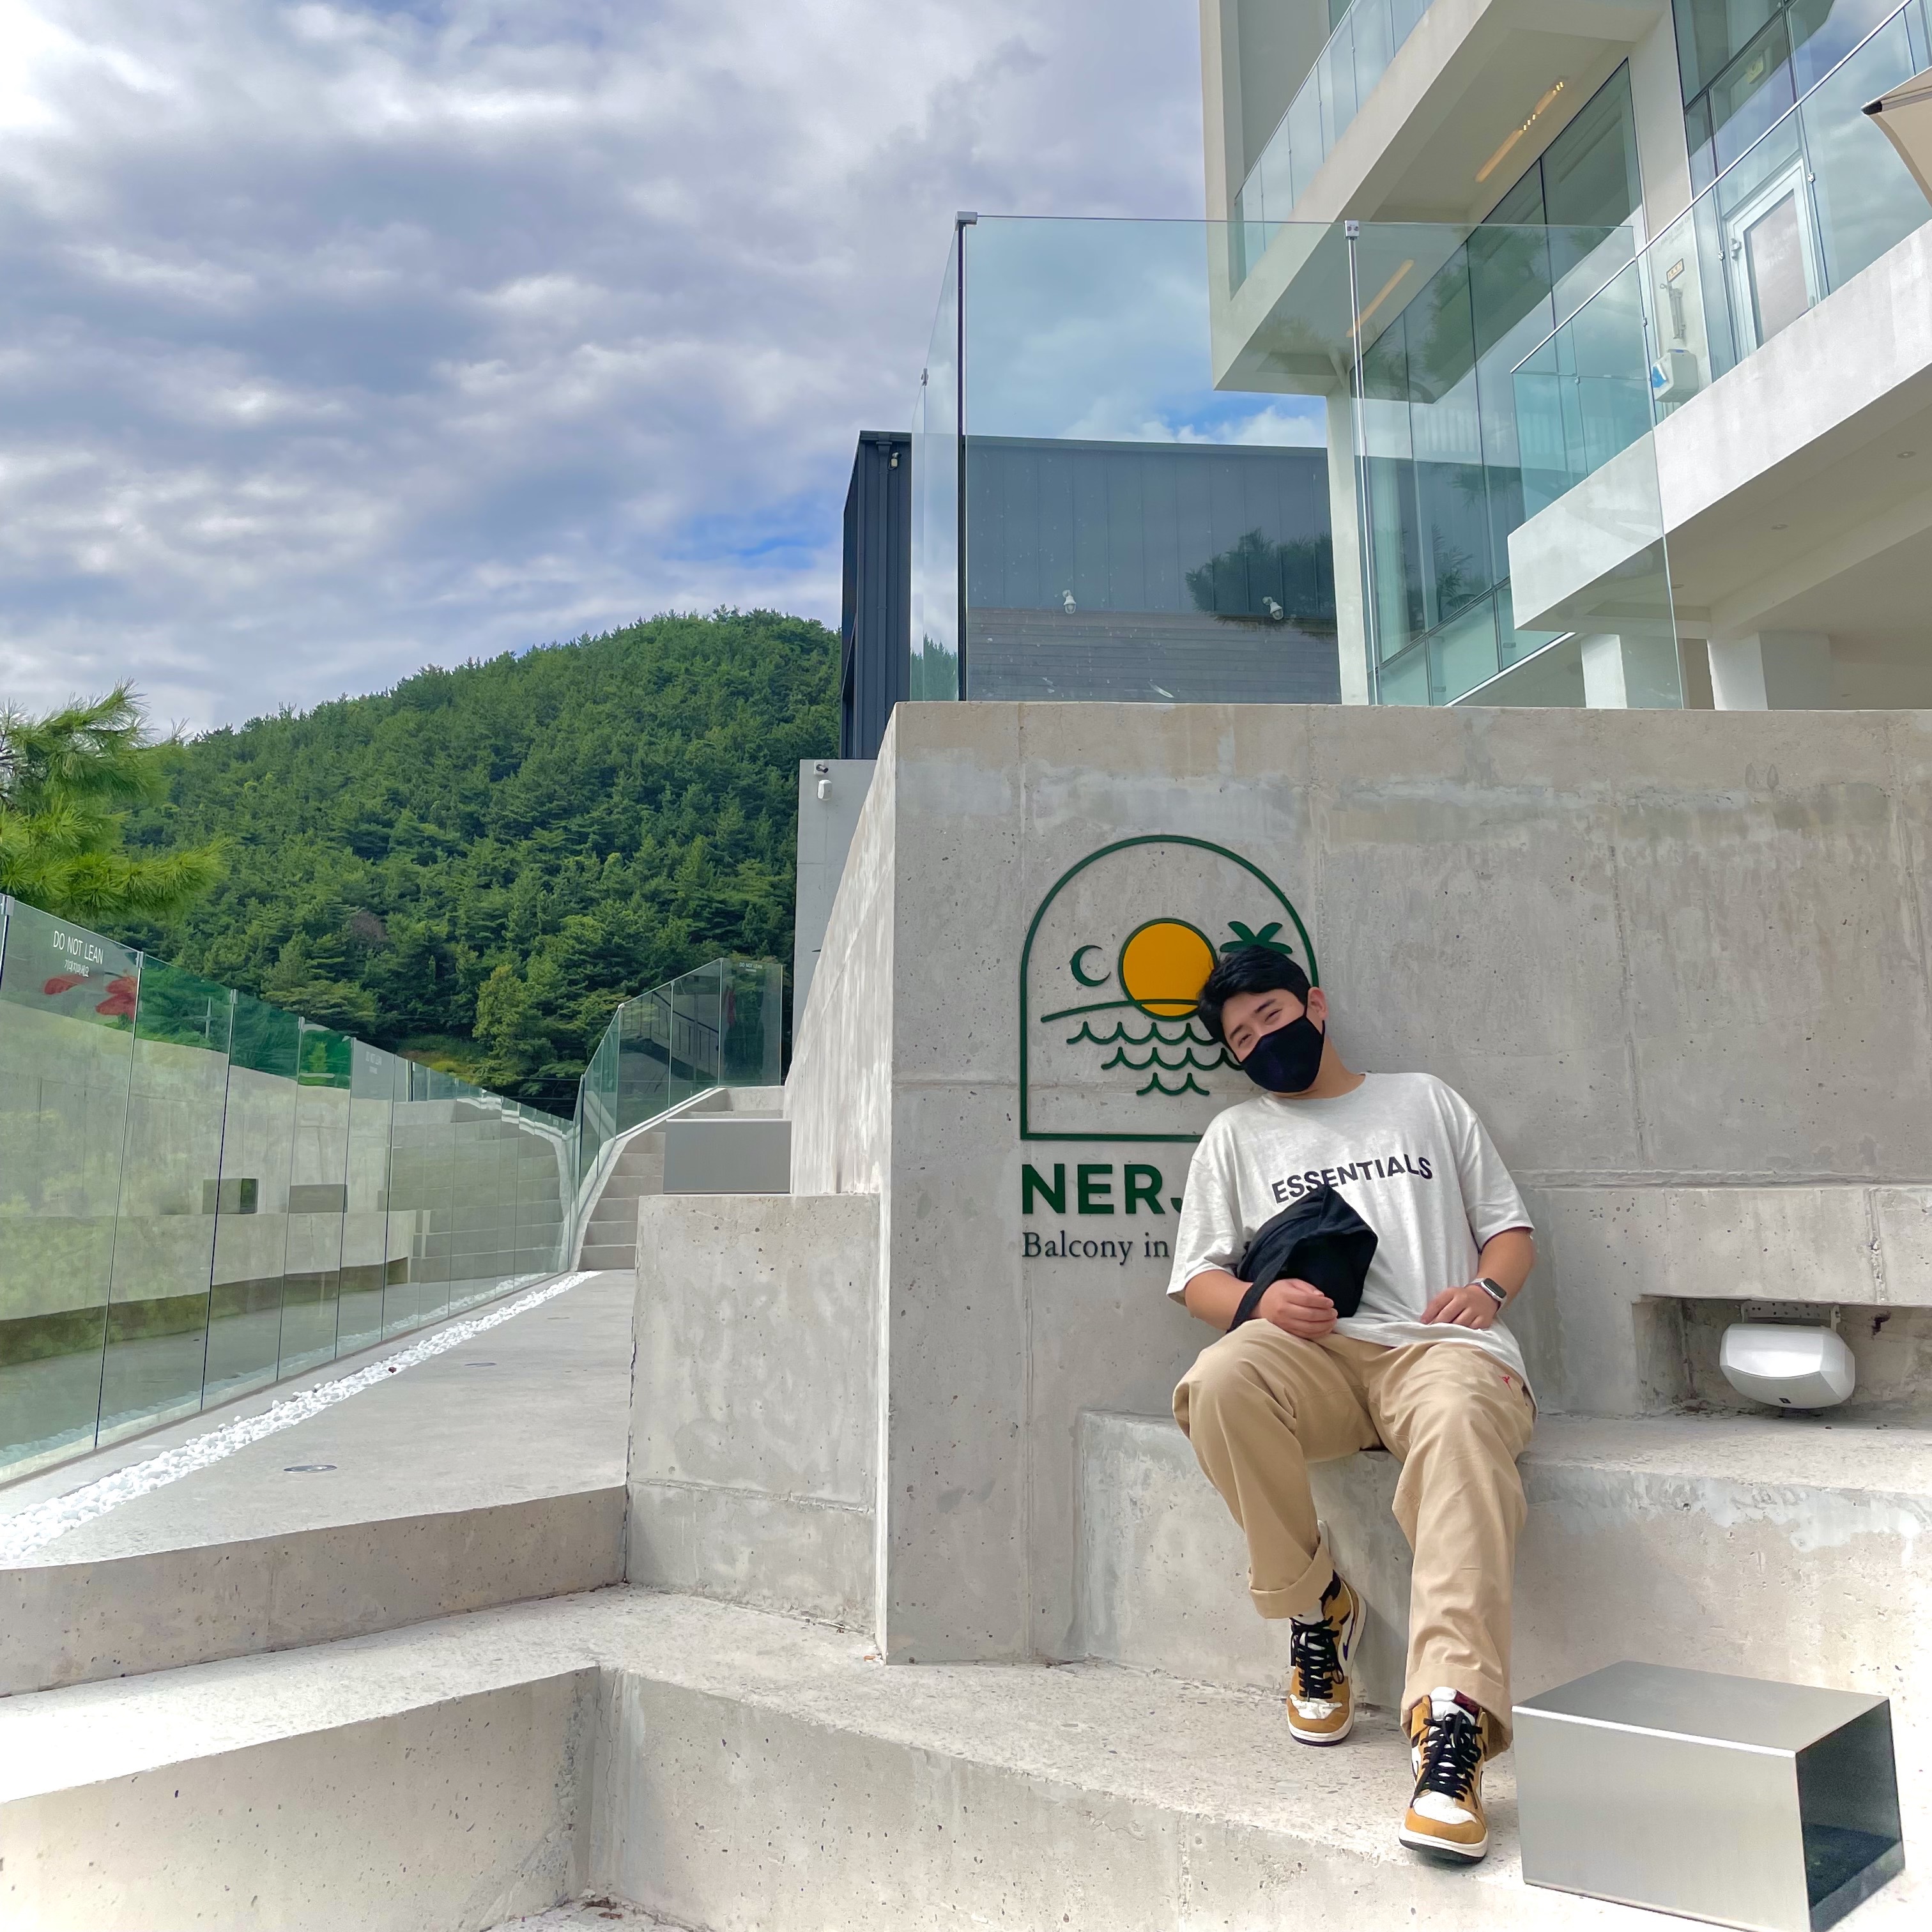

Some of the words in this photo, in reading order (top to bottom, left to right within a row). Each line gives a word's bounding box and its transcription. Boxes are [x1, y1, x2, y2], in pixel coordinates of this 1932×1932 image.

[53, 930, 65, 950] DO
[67, 936, 83, 956] NOT
[84, 943, 103, 965] LEAN
[1022, 1163, 1183, 1214] NER
[1271, 1154, 1432, 1203] ESSENTIALS
[1022, 1230, 1133, 1266] Balcony
[1144, 1232, 1169, 1257] in
